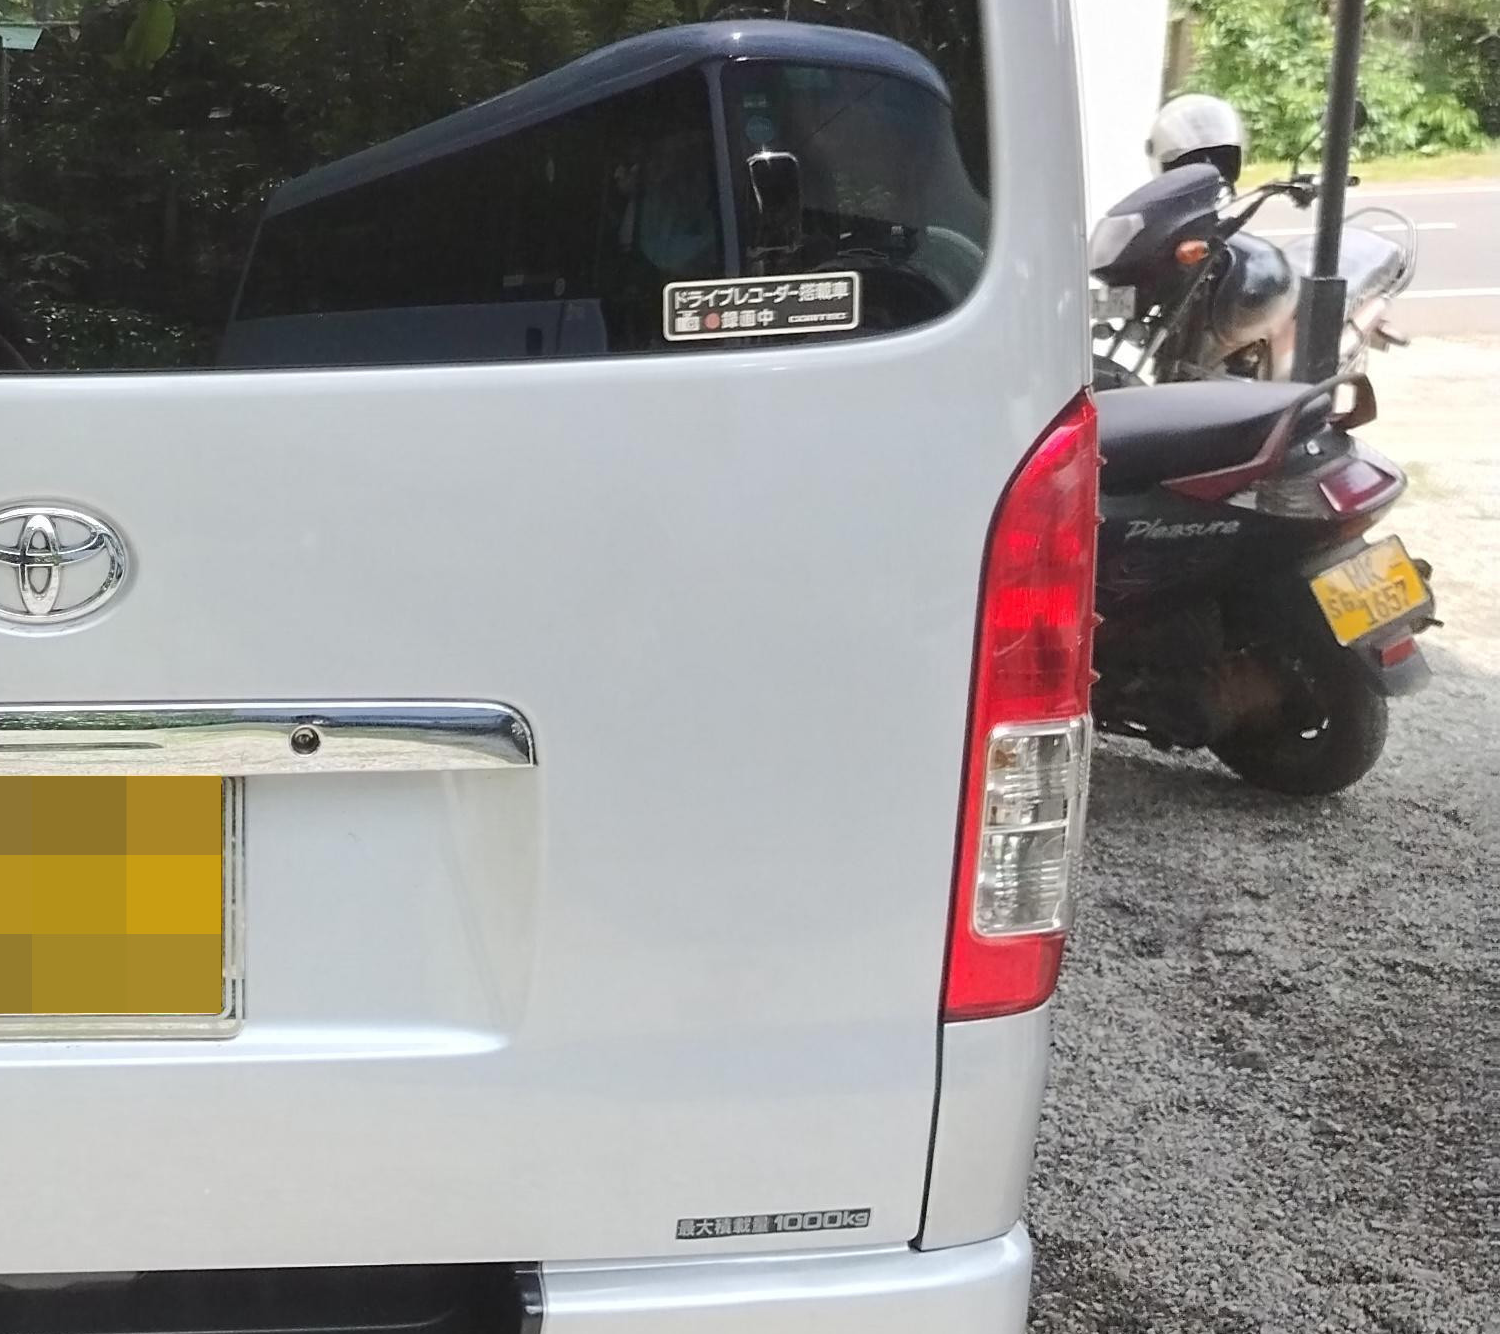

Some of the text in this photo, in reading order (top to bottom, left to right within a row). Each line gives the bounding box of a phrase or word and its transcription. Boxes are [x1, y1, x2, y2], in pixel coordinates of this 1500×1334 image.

[721, 308, 775, 329] 録画中
[1124, 517, 1240, 541] Pleasure
[774, 1211, 869, 1232] 1000kg
